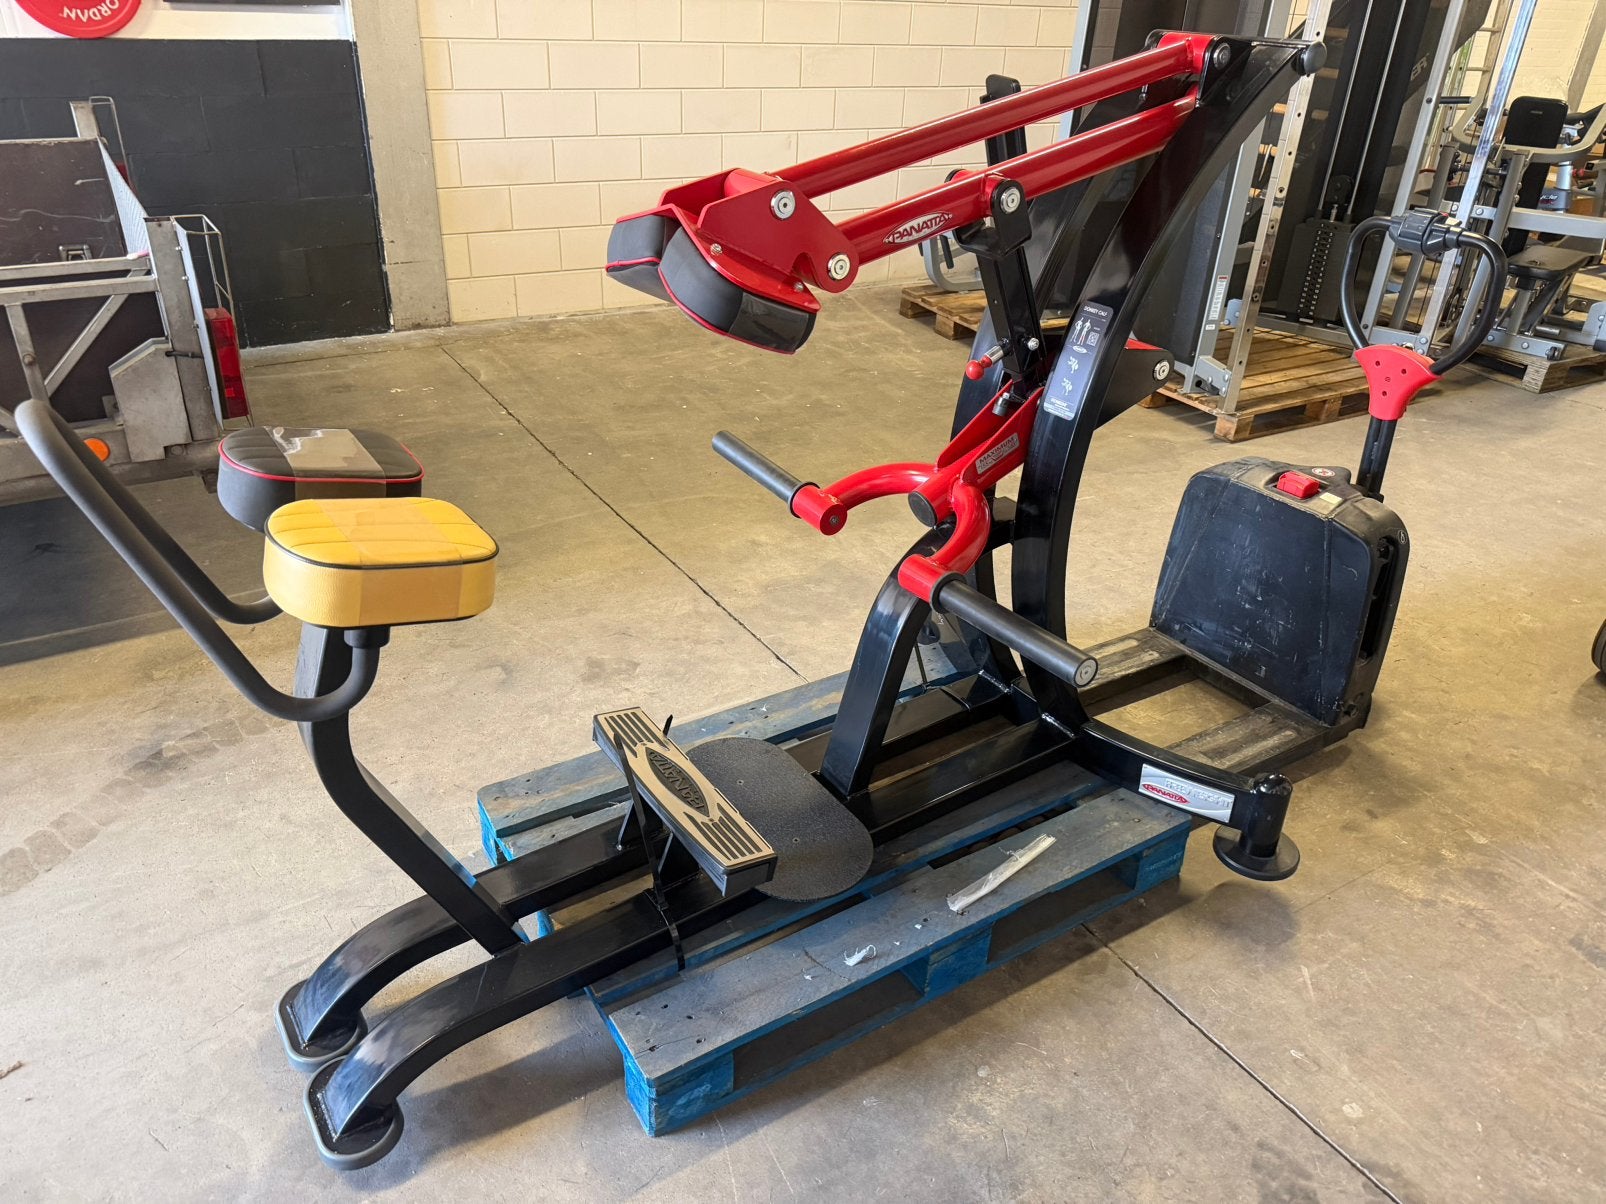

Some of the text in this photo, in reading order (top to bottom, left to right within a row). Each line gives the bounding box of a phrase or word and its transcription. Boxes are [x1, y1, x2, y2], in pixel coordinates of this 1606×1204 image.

[889, 212, 951, 243] PANATTA
[979, 436, 1017, 463] MAXIMUM
[650, 751, 706, 810] PANATTA
[1144, 784, 1188, 804] PANATTA
